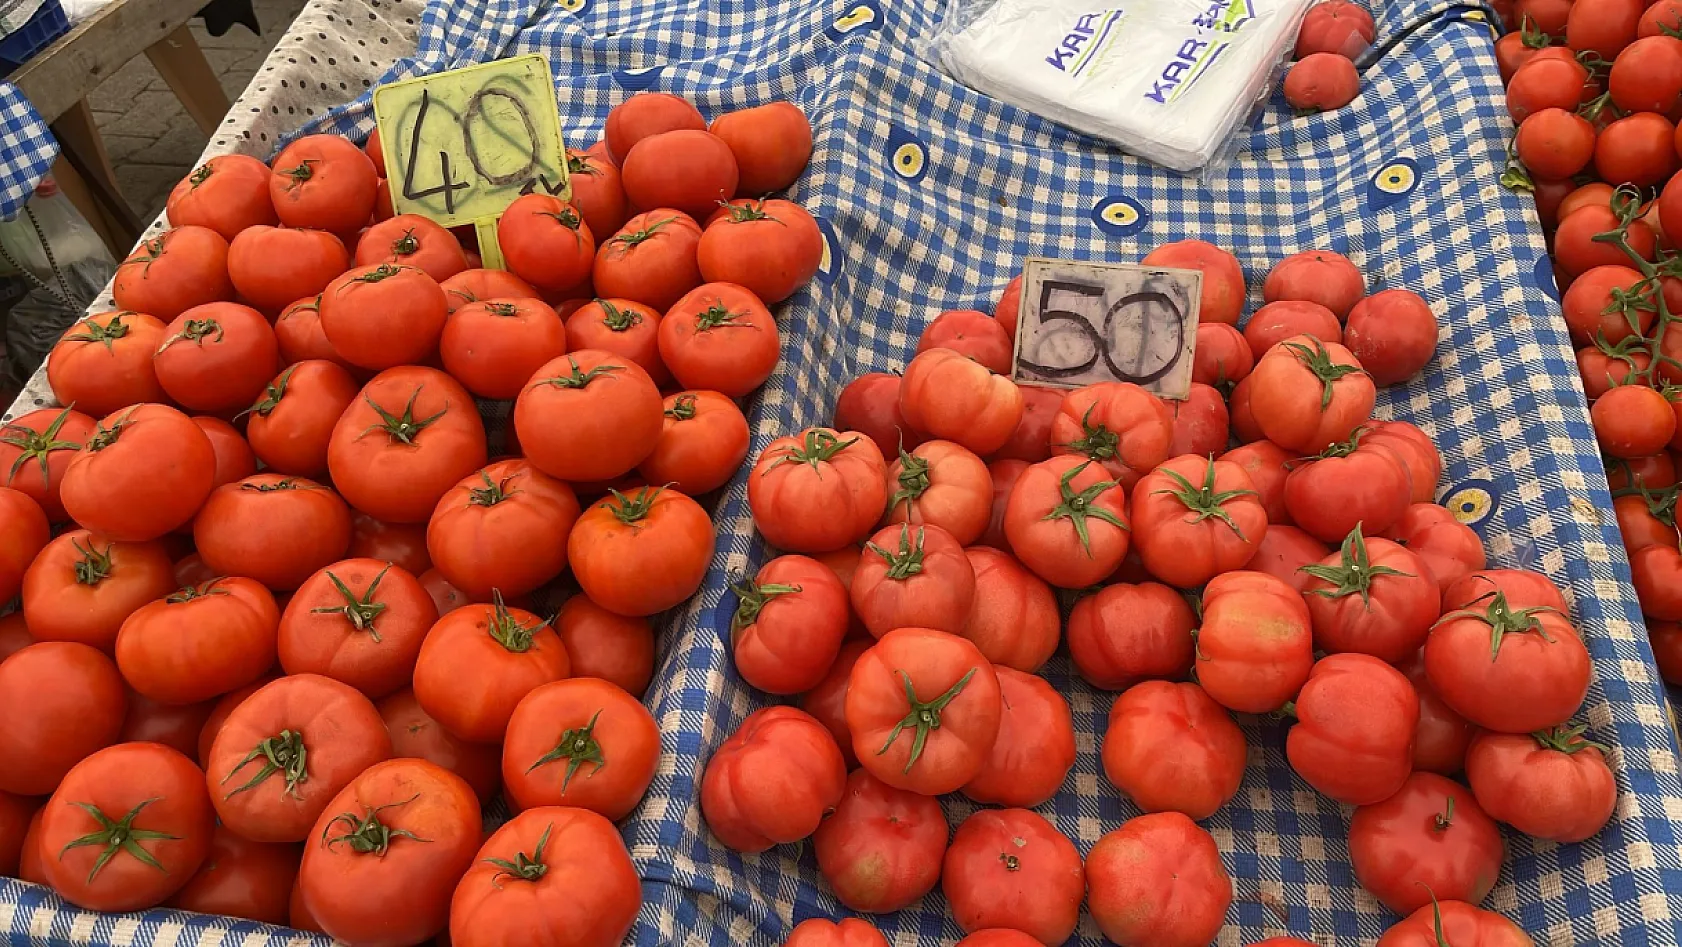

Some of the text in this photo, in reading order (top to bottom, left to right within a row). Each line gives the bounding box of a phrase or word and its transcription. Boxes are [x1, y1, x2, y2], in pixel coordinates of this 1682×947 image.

[1045, 12, 1101, 72] KAR
[1144, 38, 1208, 104] KAR
[402, 87, 541, 215] 40
[1017, 279, 1183, 386] 50
